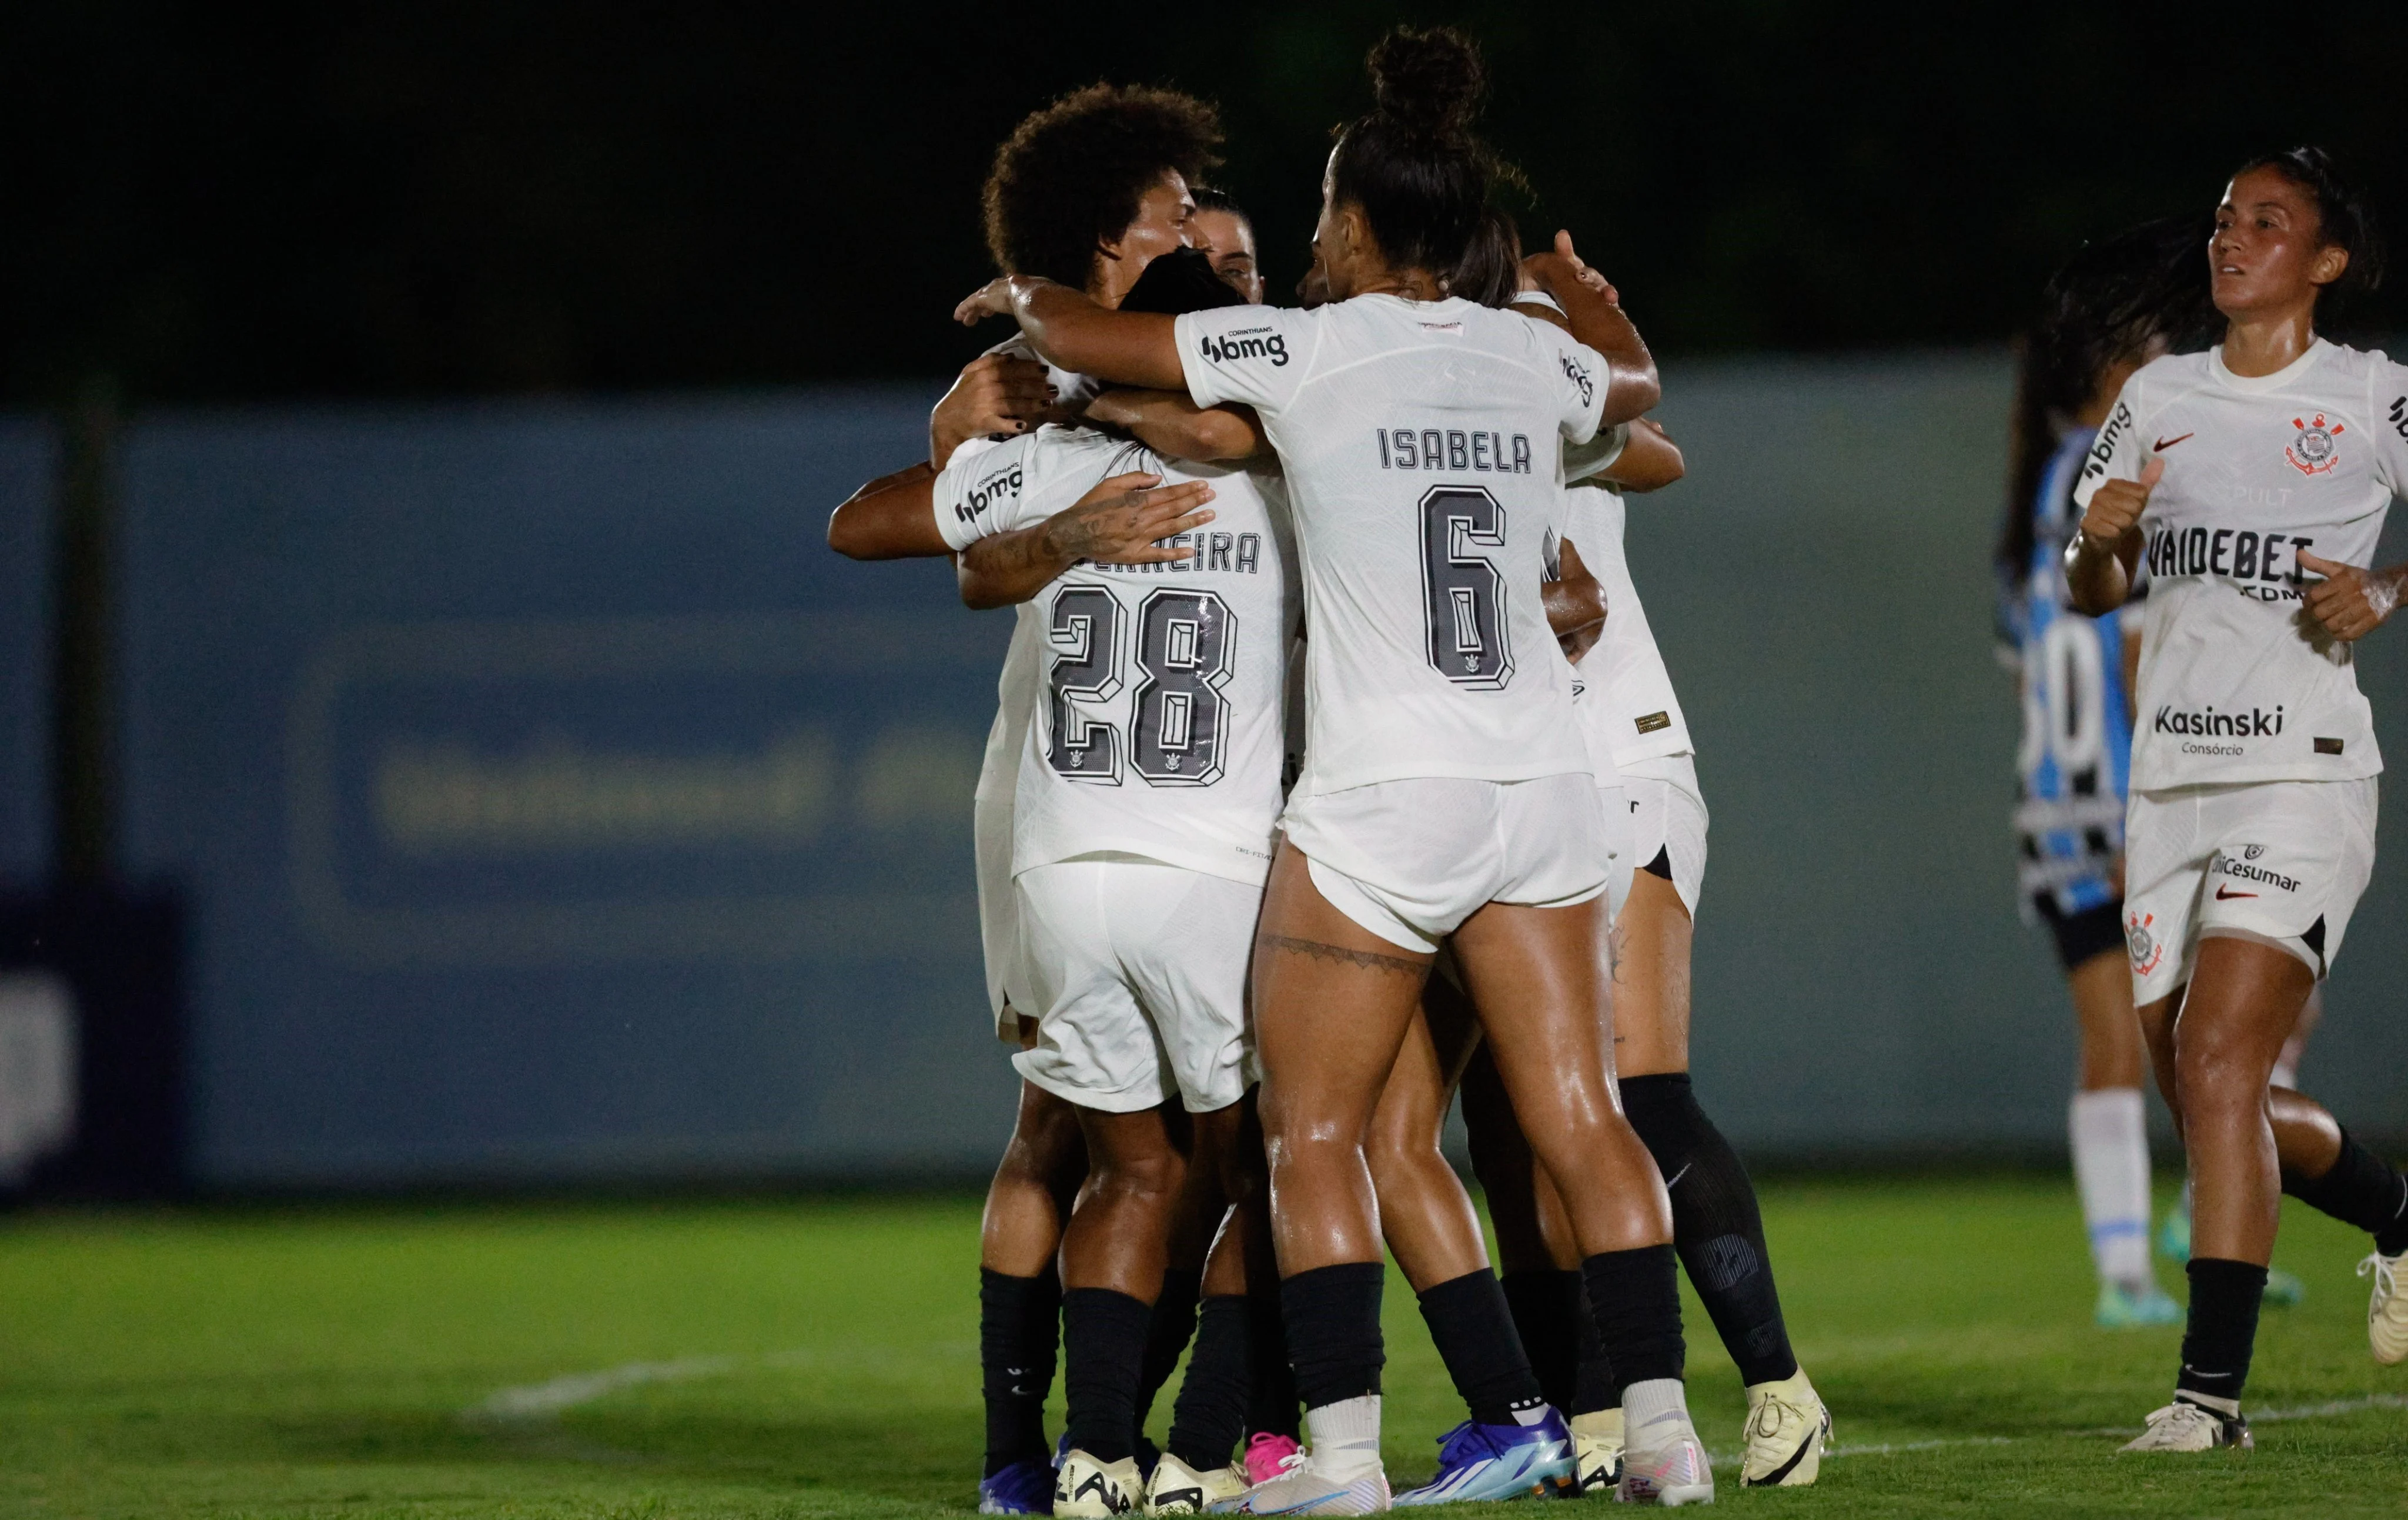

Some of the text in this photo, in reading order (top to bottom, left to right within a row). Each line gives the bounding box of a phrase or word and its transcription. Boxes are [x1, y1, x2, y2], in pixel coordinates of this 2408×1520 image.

[1218, 334, 1289, 367] bmg
[1228, 326, 1273, 337] CORINTHIANS
[1376, 429, 1531, 474] ISABELA
[2091, 401, 2132, 464] bmg
[968, 470, 1022, 515] bmg
[977, 462, 1019, 487] CORINTHIANS
[1070, 532, 1261, 574] EIRA
[2148, 527, 2313, 585] VAIDEBET
[1417, 484, 1515, 691] 6
[1046, 584, 1238, 788] 28
[2155, 705, 2283, 736] Kasinski
[2182, 741, 2243, 756] Consórcio
[1236, 846, 1265, 858] DRI-FIT
